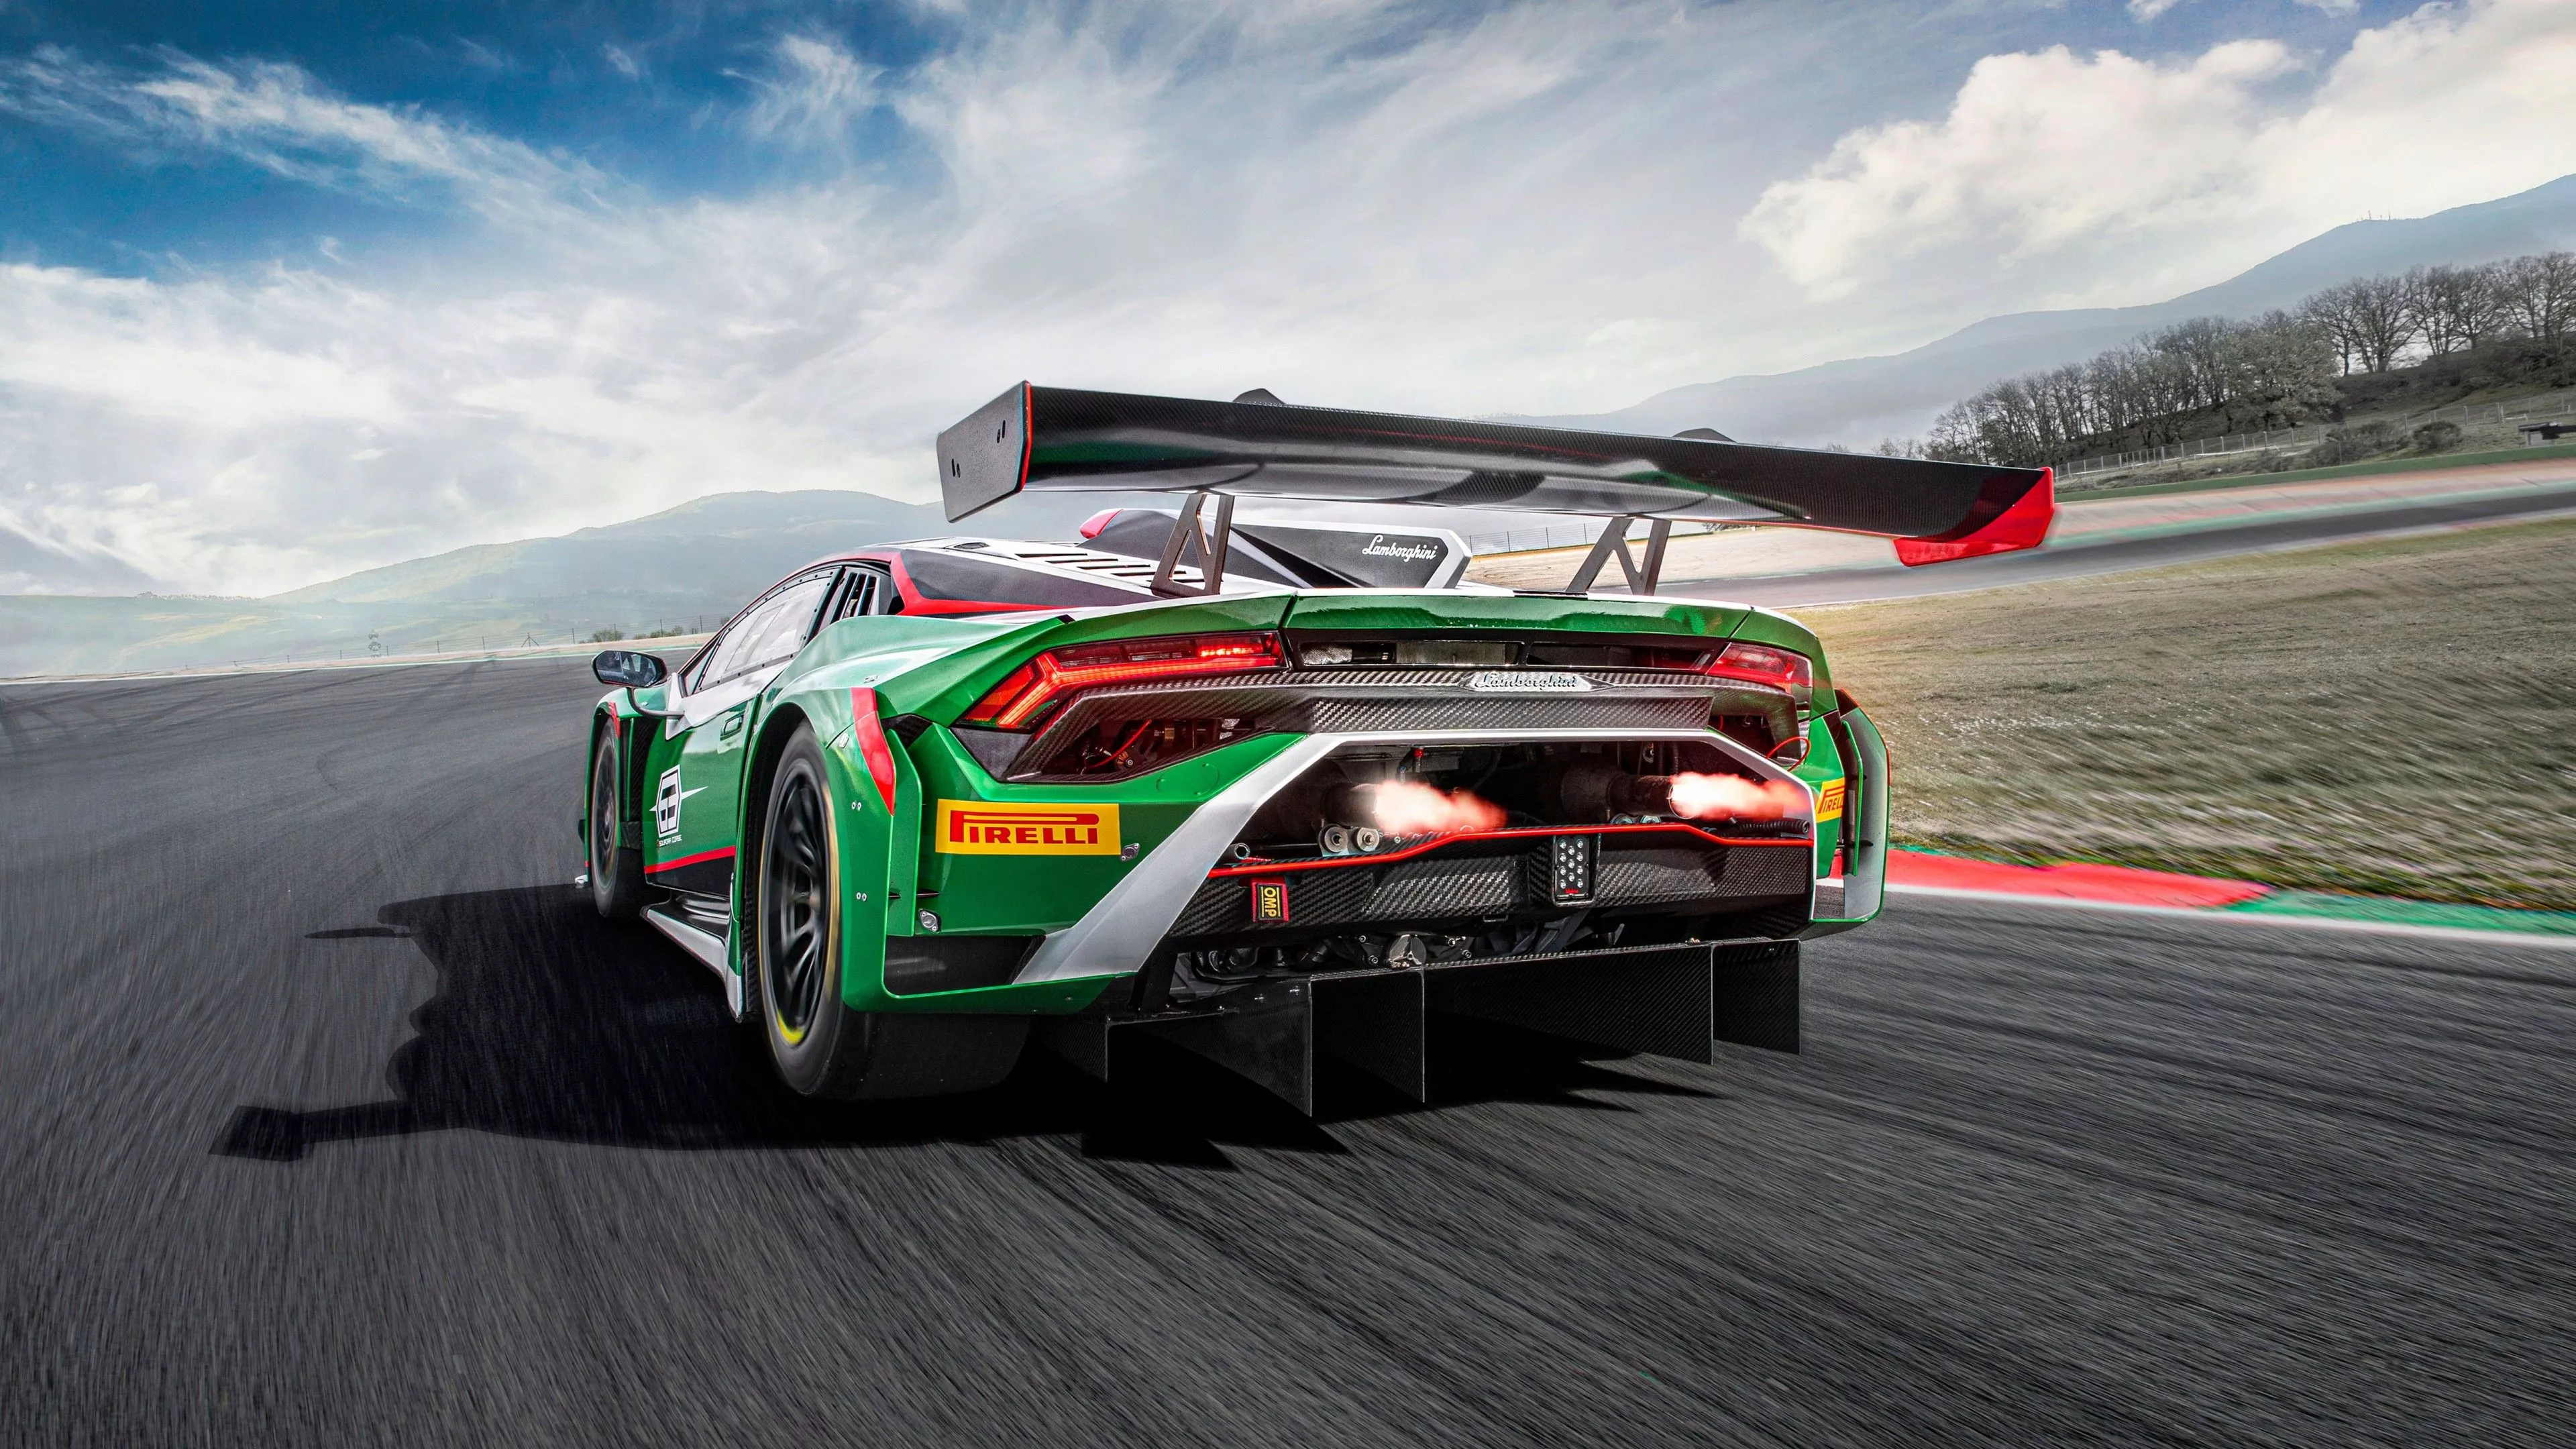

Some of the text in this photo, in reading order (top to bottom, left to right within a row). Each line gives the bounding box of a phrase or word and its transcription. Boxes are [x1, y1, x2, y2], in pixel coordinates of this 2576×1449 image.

[1362, 534, 1438, 563] Lamborghini
[1474, 672, 1578, 690] Lamborghini
[949, 810, 1099, 844] PIRELLI
[1264, 887, 1277, 917] OMP
